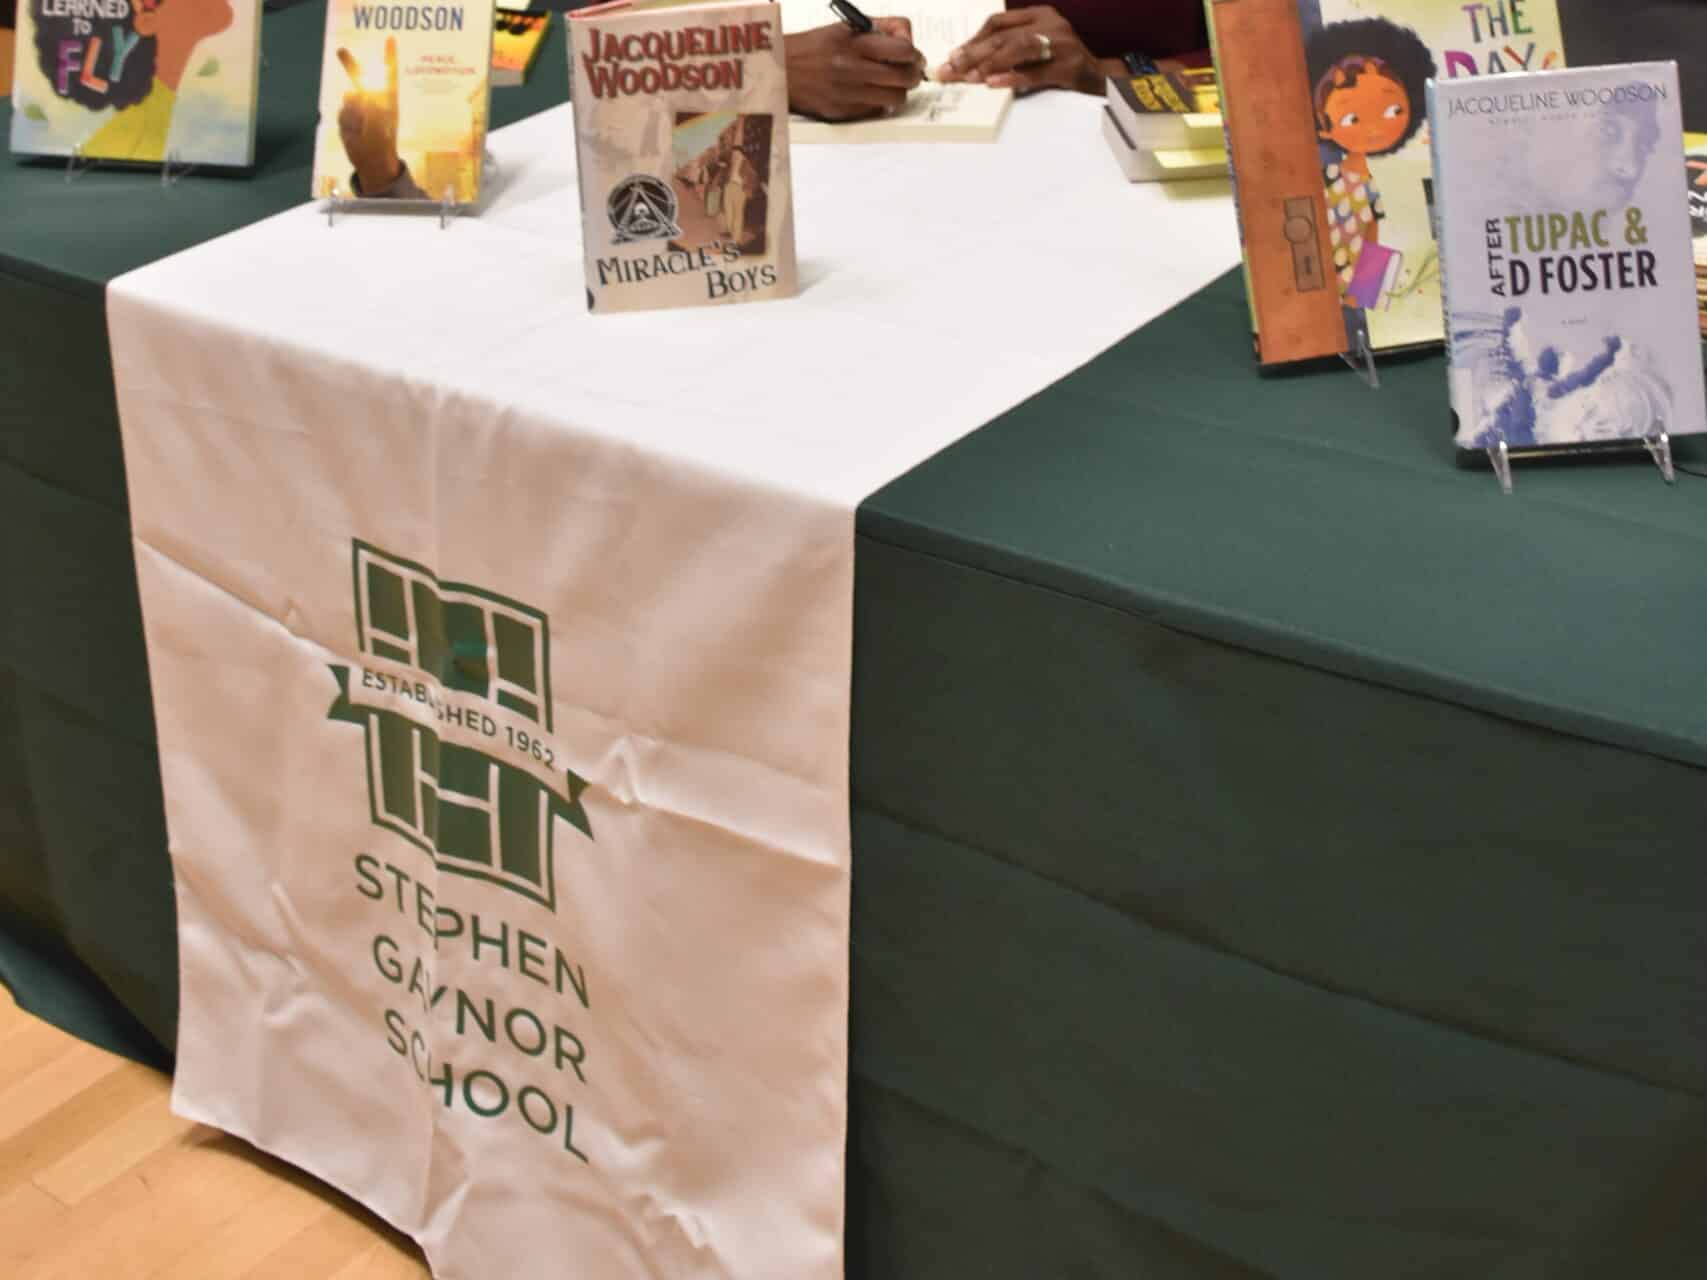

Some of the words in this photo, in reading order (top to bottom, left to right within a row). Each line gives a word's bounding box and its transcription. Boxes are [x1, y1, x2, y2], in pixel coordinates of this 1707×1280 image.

[353, 6, 464, 31] WOODSON
[57, 25, 140, 95] FLY
[581, 21, 773, 64] JACQUELINE
[583, 59, 743, 99] WOODSON
[1448, 91, 1561, 117] JACQUELINE
[1563, 83, 1668, 106] WOODSON
[1504, 209, 1609, 255] TUPAC
[1623, 207, 1648, 245] &
[706, 264, 777, 298] BOYS
[1486, 218, 1505, 297] AFTER
[1508, 258, 1530, 296] D
[1539, 249, 1658, 295] FOSTER
[505, 725, 555, 771] 1962
[354, 853, 590, 1009] STEPHEN
[372, 934, 586, 1083] GAYNOR
[384, 1009, 589, 1164] SCHOOL
